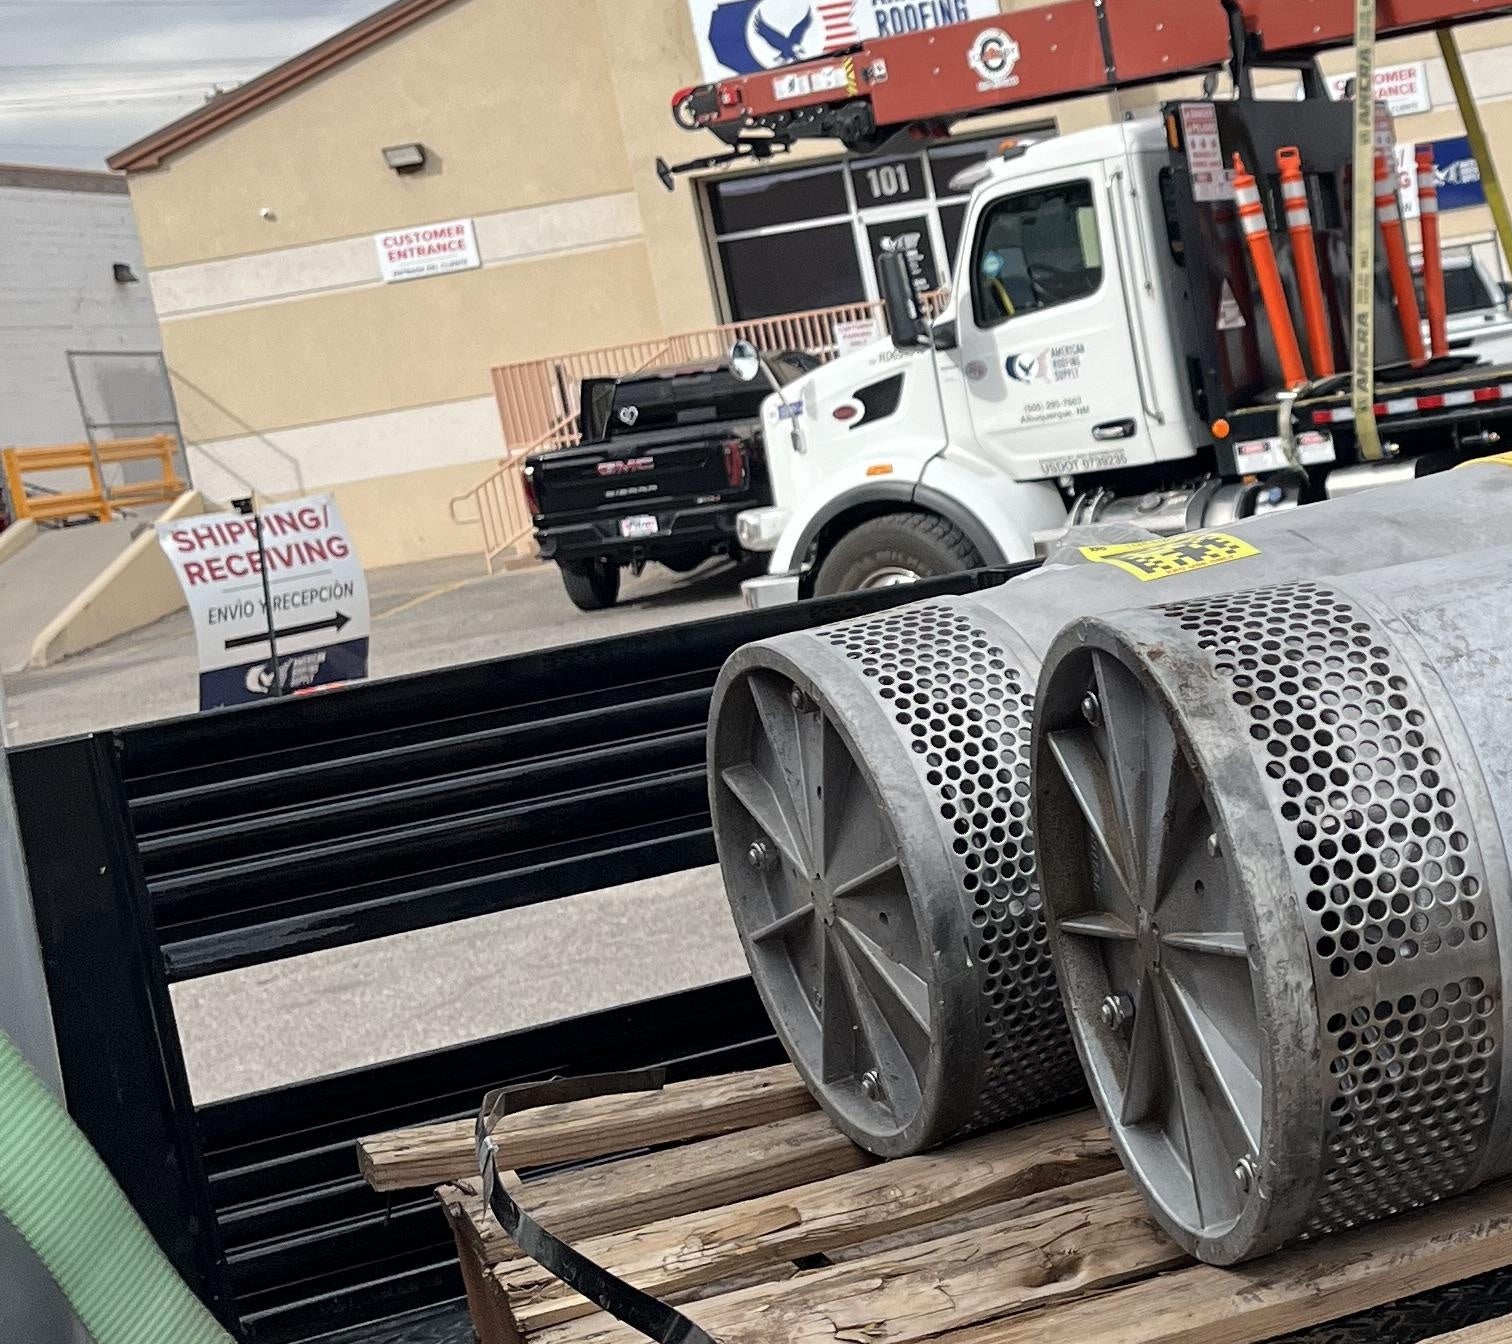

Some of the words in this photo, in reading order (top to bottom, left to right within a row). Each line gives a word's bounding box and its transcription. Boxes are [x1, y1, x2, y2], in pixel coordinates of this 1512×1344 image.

[1335, 68, 1417, 91] COMER
[867, 163, 910, 198] 101
[383, 225, 464, 248] CUSTOMER
[388, 239, 465, 262] ENTRANCE
[597, 456, 655, 477] GMC
[171, 505, 329, 553] SHIPPING/
[184, 536, 350, 587] RECEIVING
